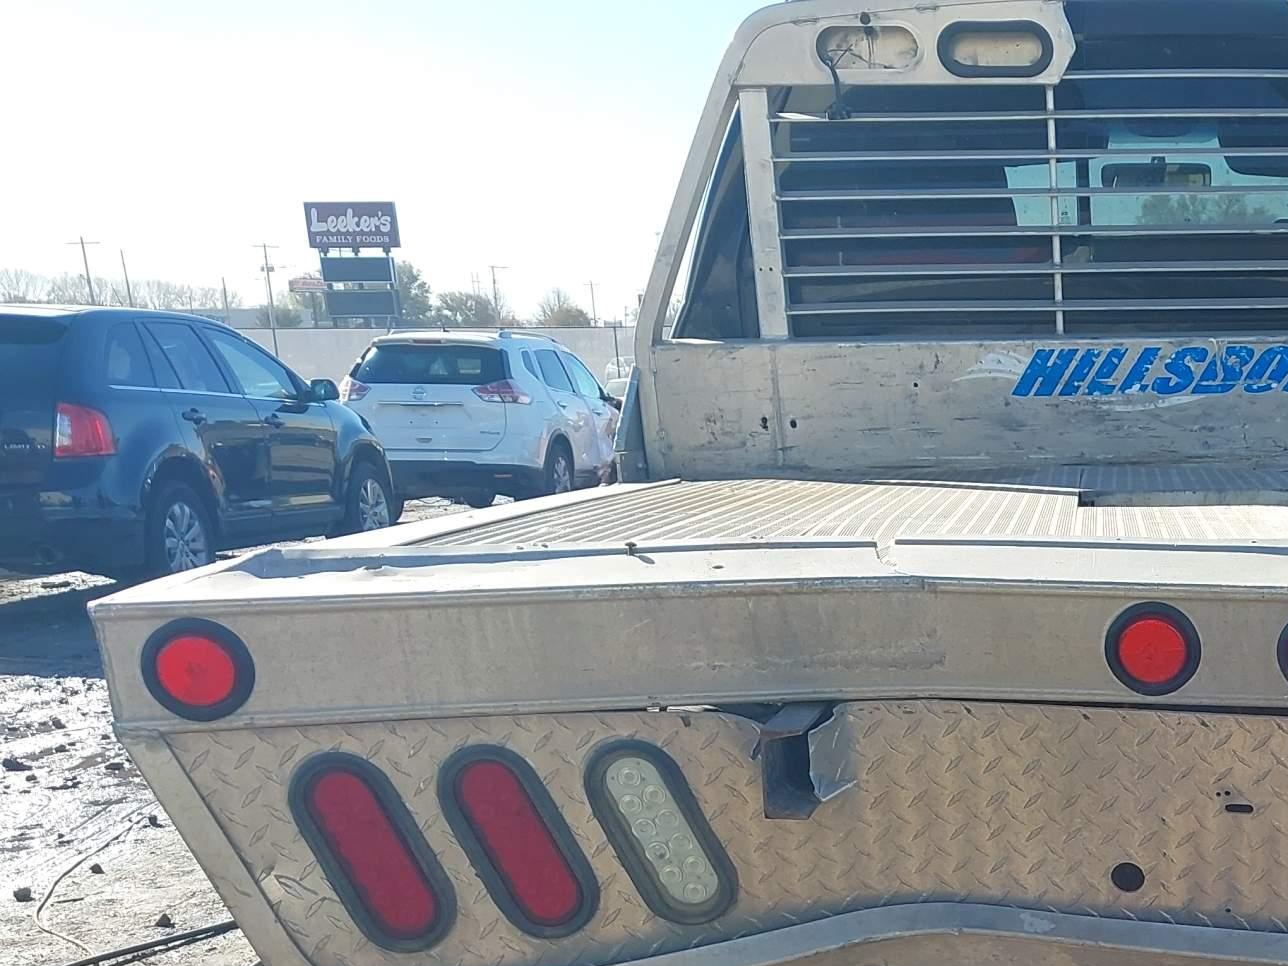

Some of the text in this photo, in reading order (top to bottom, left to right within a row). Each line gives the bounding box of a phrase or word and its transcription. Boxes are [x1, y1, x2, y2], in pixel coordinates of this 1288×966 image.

[310, 207, 391, 232] Leeker's
[315, 235, 390, 243] FAMILY FOODS
